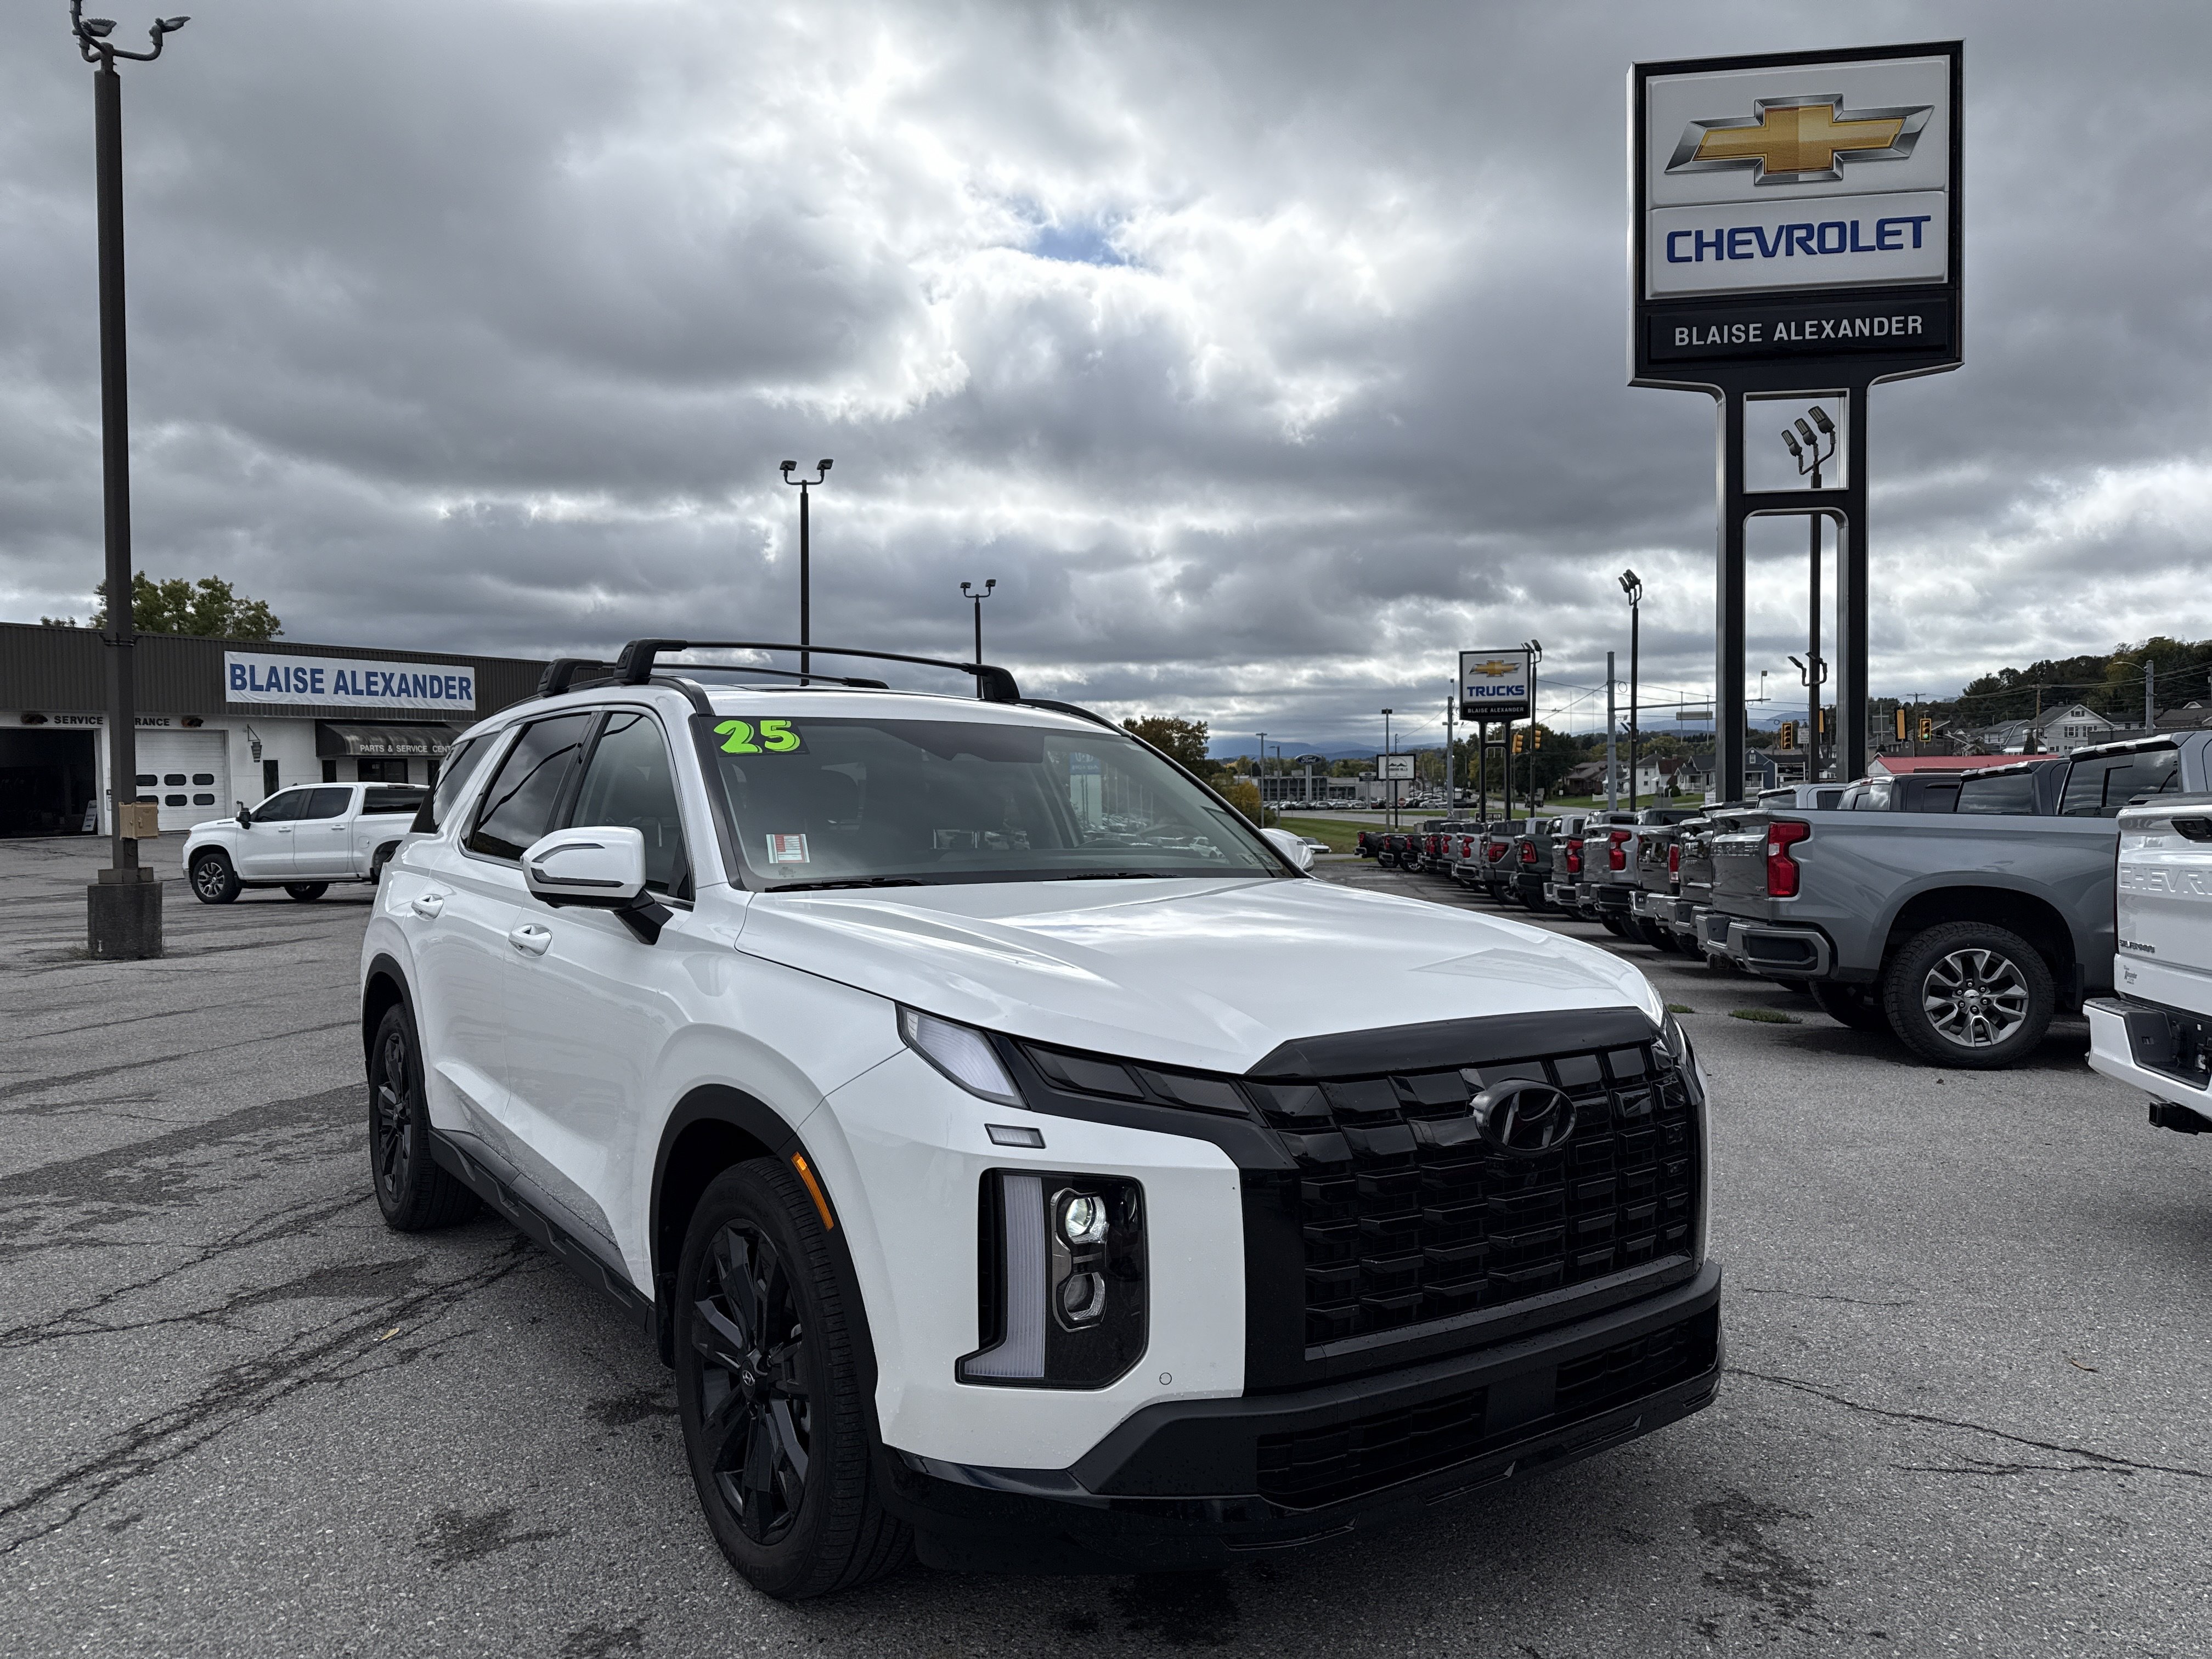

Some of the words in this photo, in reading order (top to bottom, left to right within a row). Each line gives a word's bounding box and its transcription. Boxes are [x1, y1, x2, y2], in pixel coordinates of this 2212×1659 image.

[1667, 215, 1931, 262] CHEVROLET
[1674, 323, 1763, 347] BLAISE
[1773, 314, 1923, 343] ALEXANDER
[229, 663, 325, 694] BLAISE
[332, 669, 473, 701] ALEXANDER
[1466, 685, 1525, 697] TRUCKS
[54, 715, 104, 725] SERVICE
[134, 717, 170, 727] RANCE
[713, 719, 801, 754] 25
[360, 744, 385, 753] PARTS
[387, 744, 393, 753] &
[396, 744, 428, 753] SERVICE
[432, 745, 452, 753] CENT
